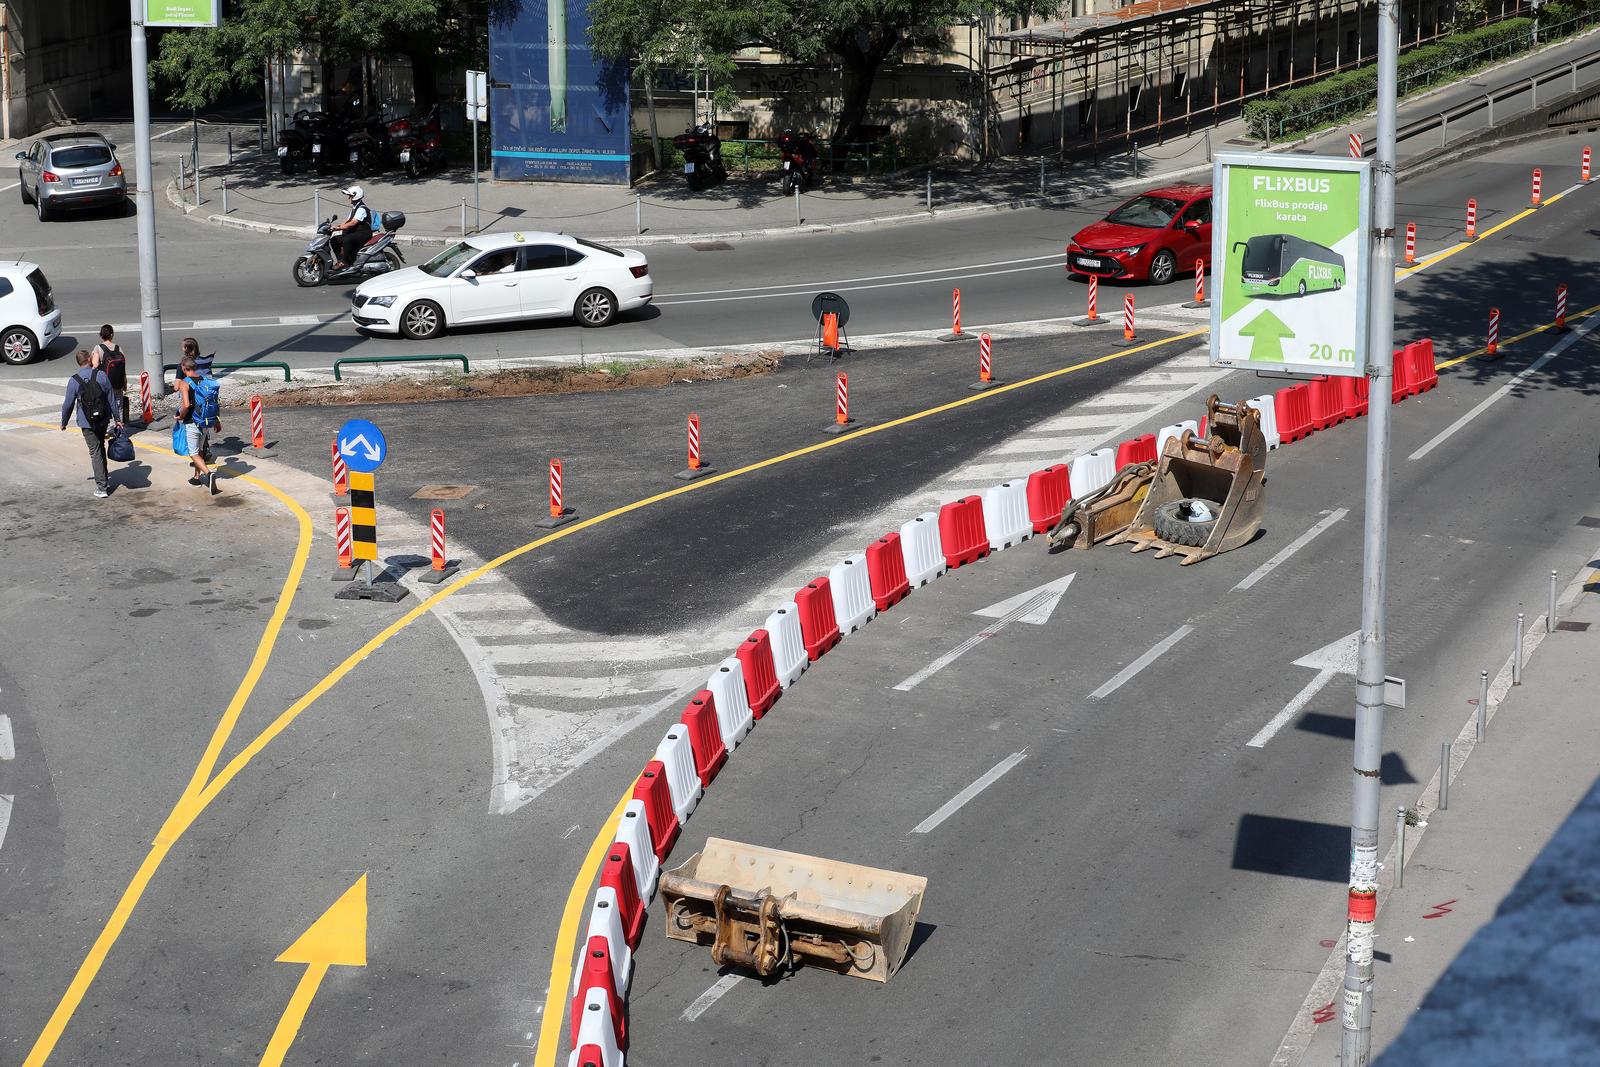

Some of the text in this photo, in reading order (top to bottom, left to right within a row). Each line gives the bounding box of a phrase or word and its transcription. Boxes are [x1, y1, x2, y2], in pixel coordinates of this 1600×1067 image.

[1255, 199, 1329, 212] FlixBus prodaja
[1276, 212, 1307, 222] karata
[1309, 343, 1355, 363] 20 m
